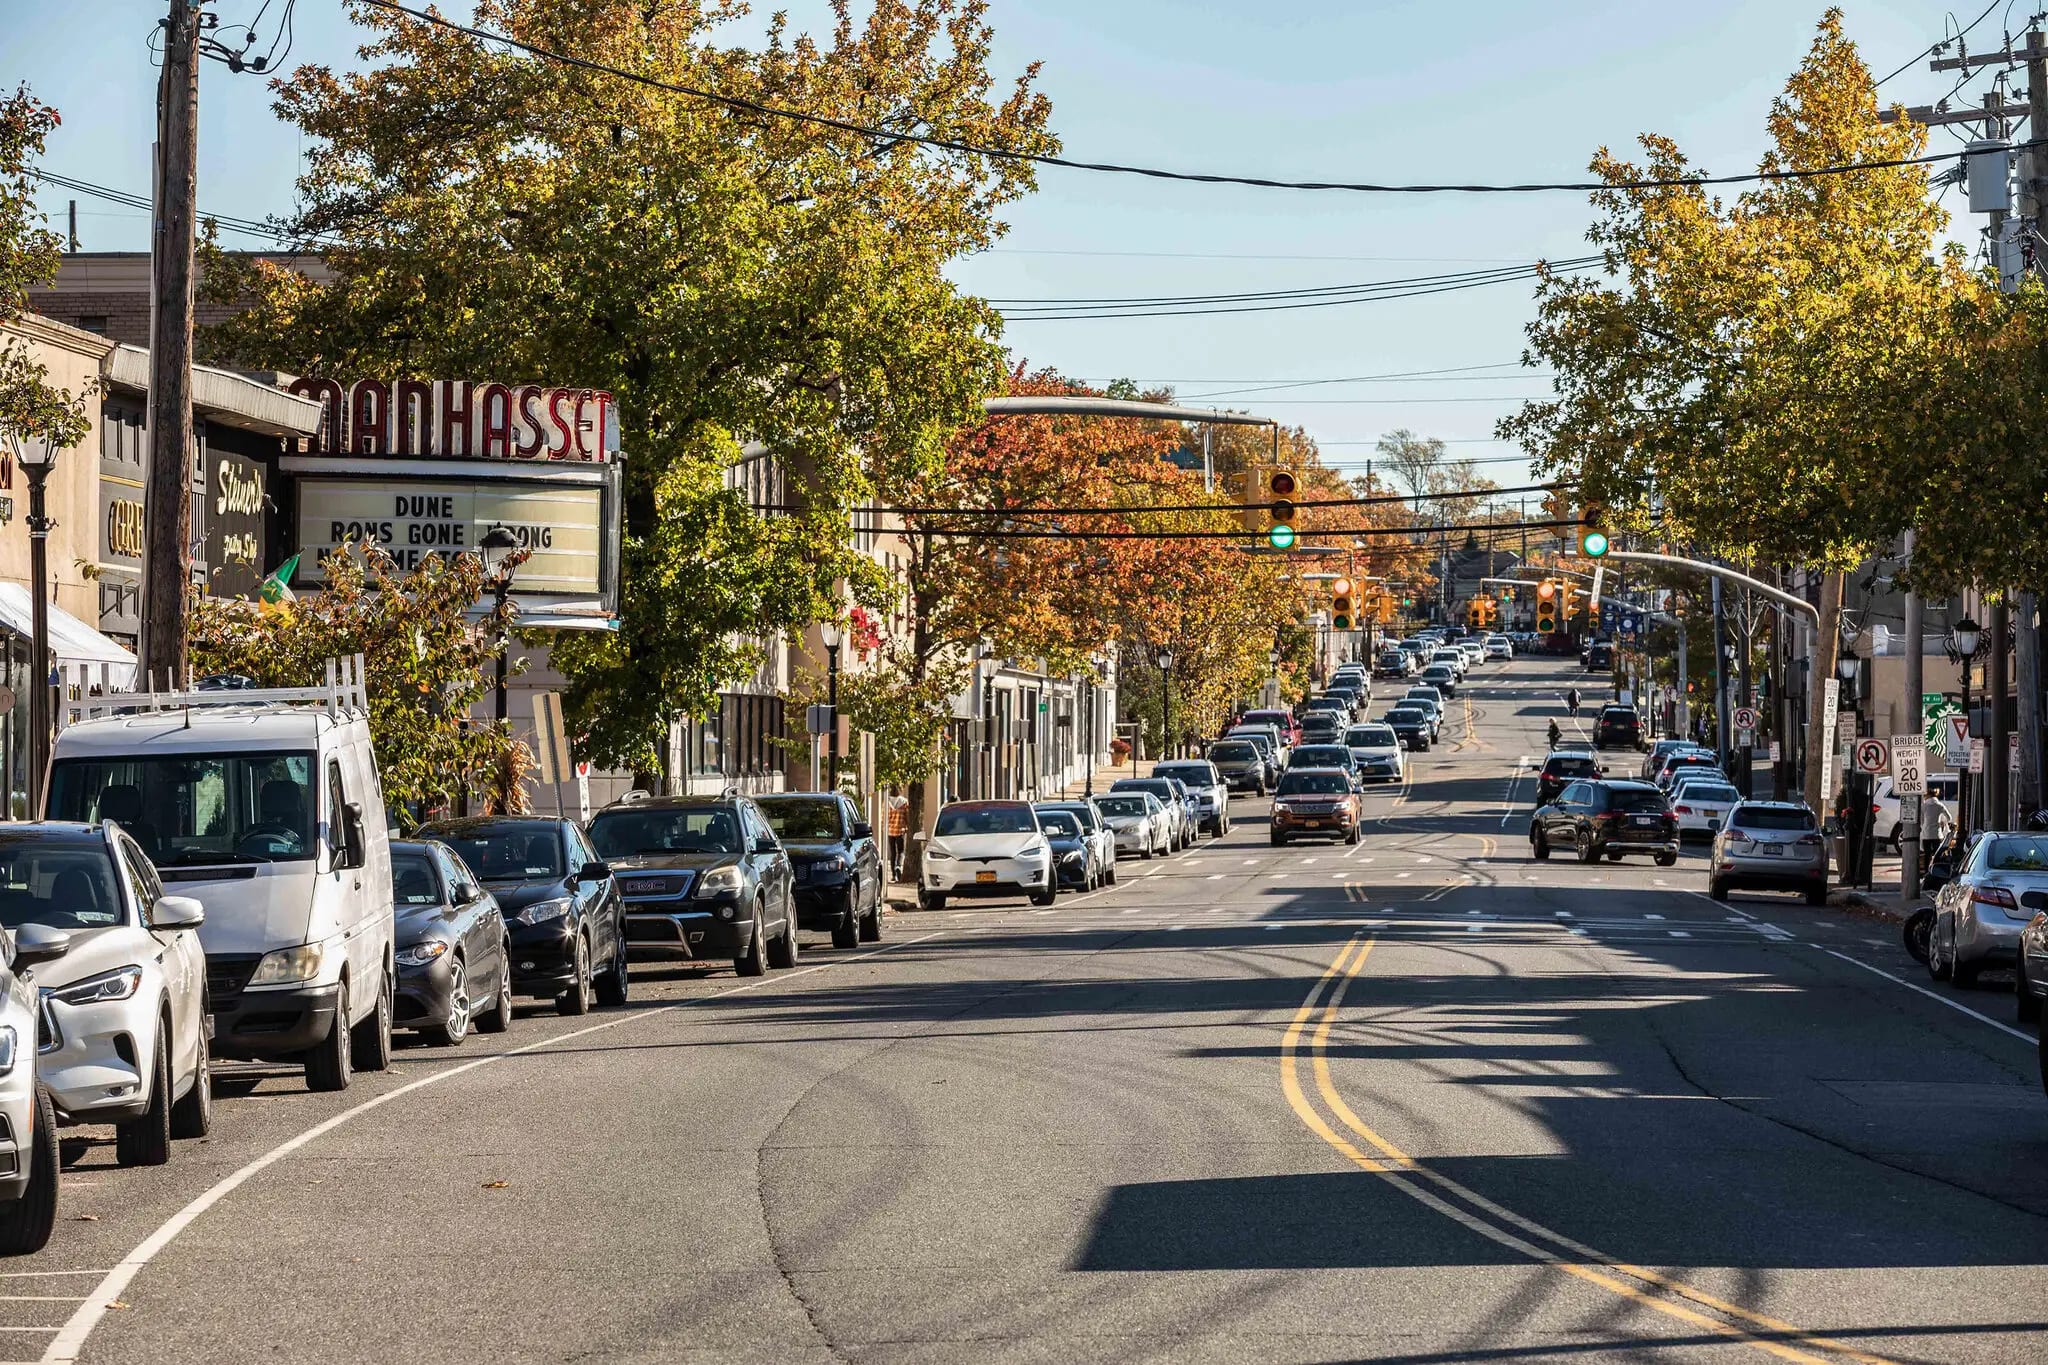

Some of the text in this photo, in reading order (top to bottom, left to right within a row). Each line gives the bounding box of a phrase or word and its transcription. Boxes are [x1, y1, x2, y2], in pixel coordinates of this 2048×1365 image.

[288, 378, 613, 462] MANHASSET
[395, 495, 453, 518] DUNE
[331, 521, 552, 549] RONS GONE ONG
[1894, 736, 1923, 746] BRIDGE
[1896, 749, 1922, 758] WEIGHT
[1900, 759, 1918, 767] LIMIT
[1900, 767, 1918, 782] 20
[1898, 782, 1922, 792] TONS
